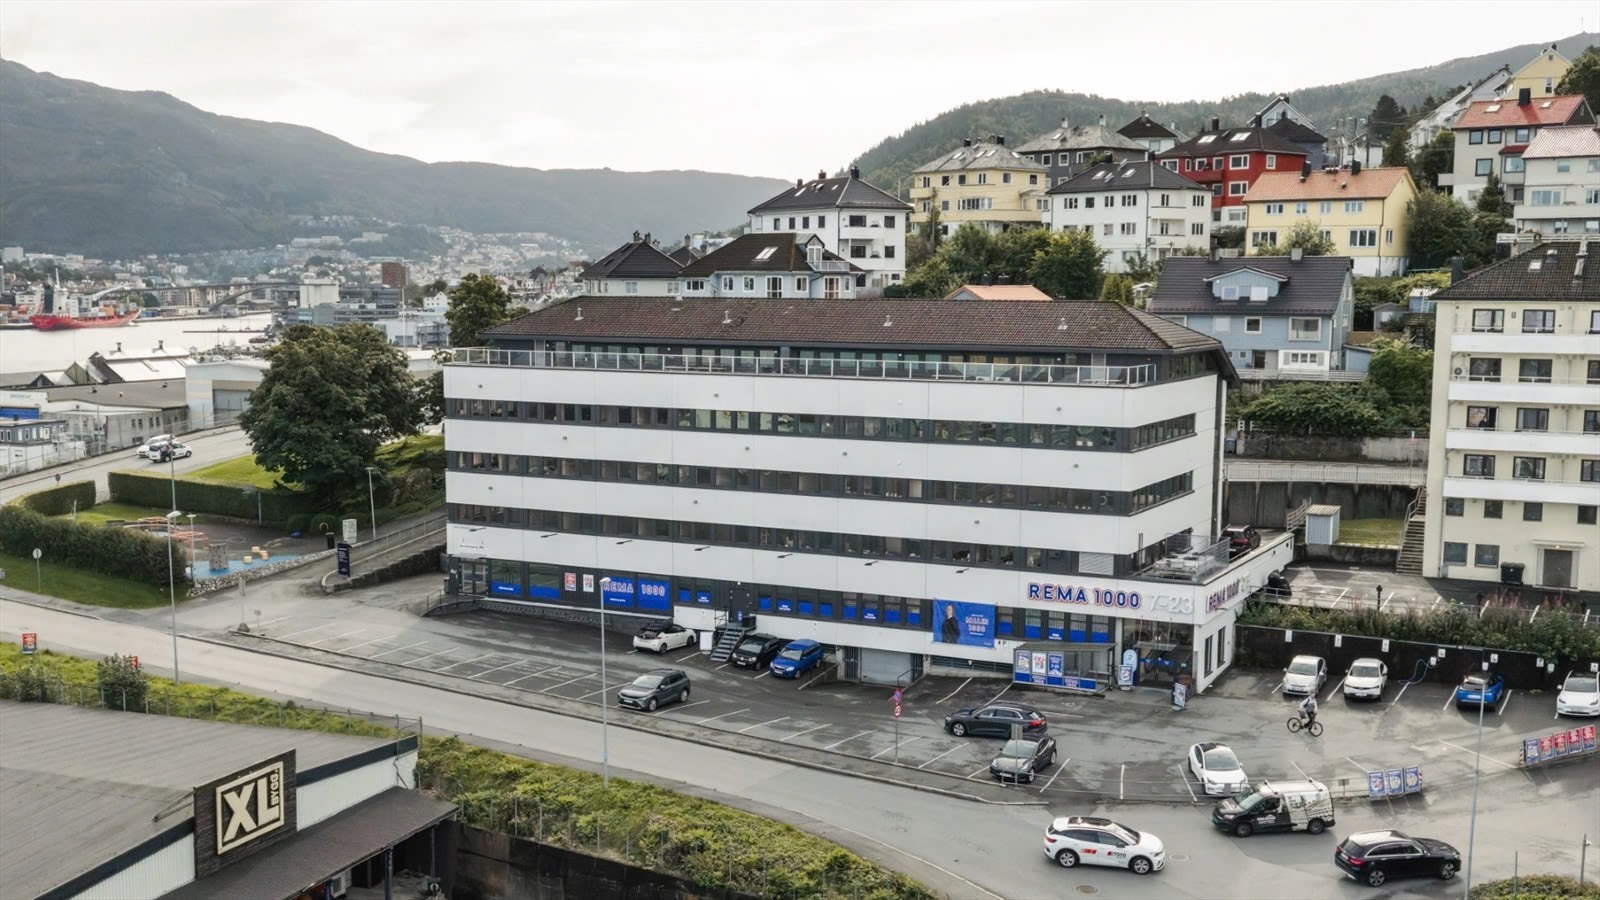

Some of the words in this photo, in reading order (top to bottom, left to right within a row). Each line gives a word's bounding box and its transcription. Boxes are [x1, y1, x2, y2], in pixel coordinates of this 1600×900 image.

[1027, 582, 1088, 605] REMA
[1093, 587, 1141, 609] 1000
[223, 777, 280, 842] XL
